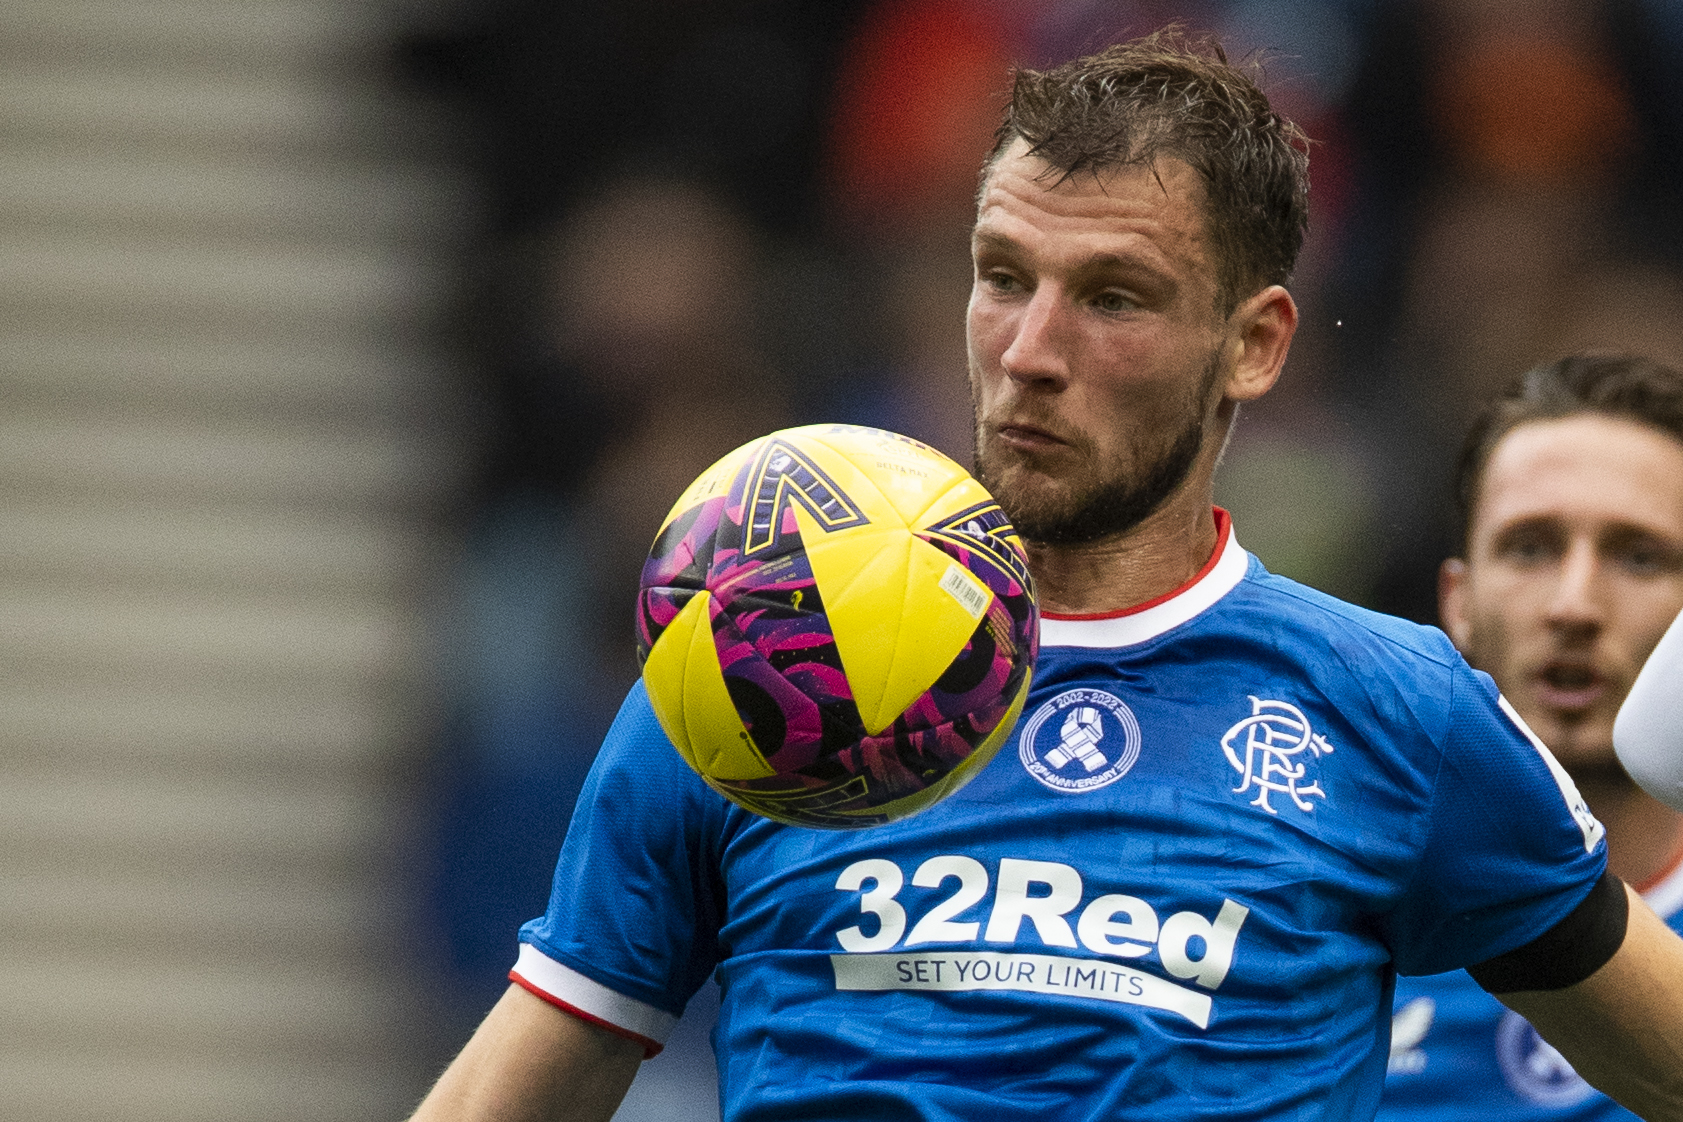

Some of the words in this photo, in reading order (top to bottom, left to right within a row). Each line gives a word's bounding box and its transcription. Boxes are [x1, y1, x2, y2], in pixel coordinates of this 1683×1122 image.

[1046, 768, 1118, 788] ANNIVERSARY
[835, 855, 1250, 990] 32Red
[896, 960, 946, 983] SET
[954, 960, 1036, 984] YOUR
[1046, 965, 1144, 997] LIMITS
